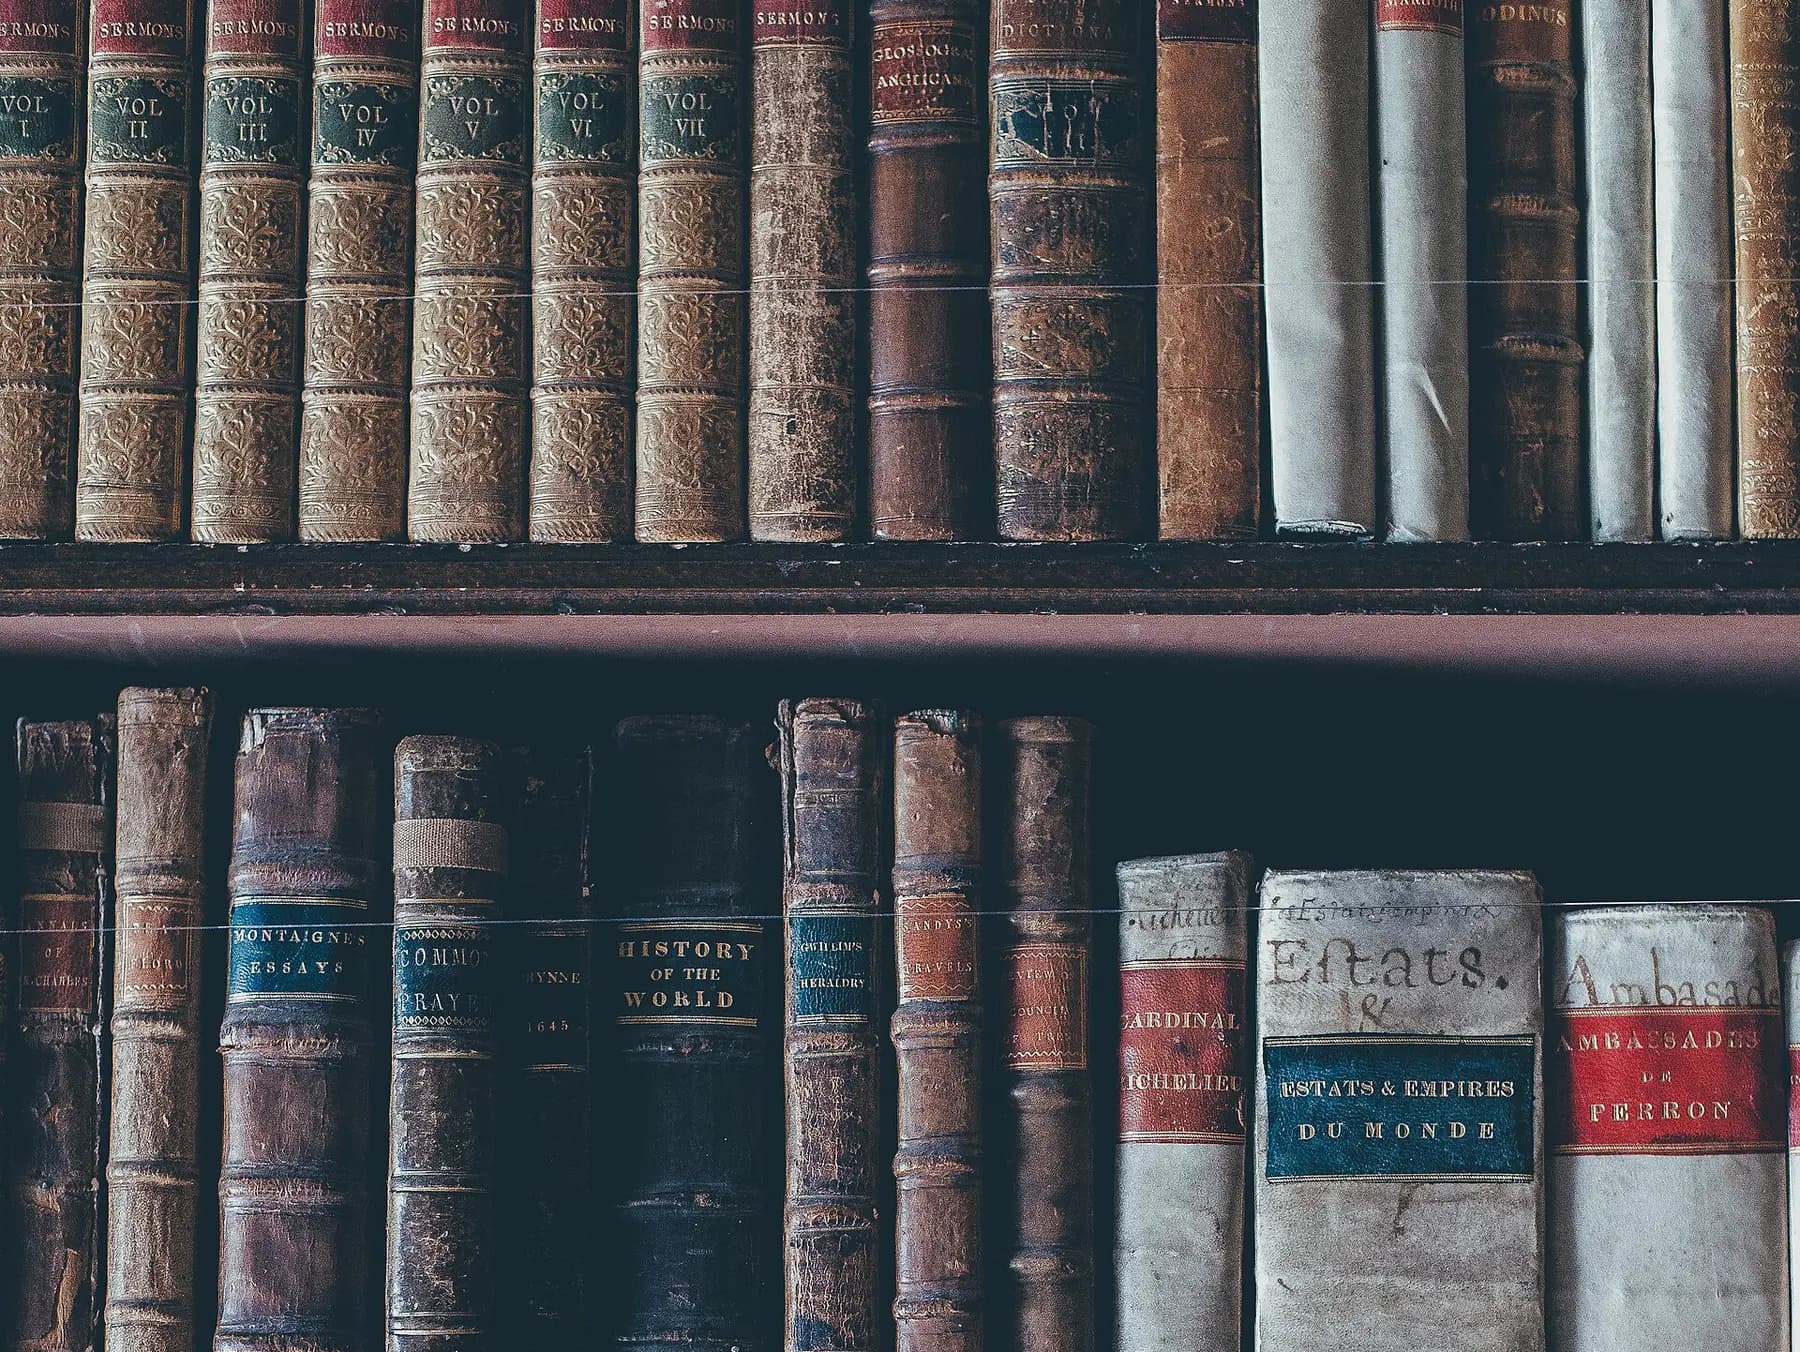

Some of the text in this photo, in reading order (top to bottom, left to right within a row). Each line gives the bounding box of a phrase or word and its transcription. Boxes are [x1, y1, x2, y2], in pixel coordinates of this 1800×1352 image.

[434, 17, 518, 35] SERMONS
[542, 17, 625, 34] SERMONS
[649, 15, 735, 33] SERMONS
[756, 11, 839, 26] SERMONS
[100, 22, 184, 39] SERMONS
[214, 21, 296, 38] SERMONS
[325, 22, 408, 42] SERMONS
[2, 96, 48, 113] VOL
[116, 97, 163, 116] VOL
[225, 96, 272, 115] VOL
[450, 96, 498, 116] VOL
[558, 92, 603, 117] VOL
[664, 92, 711, 112] VOL
[340, 104, 388, 124] VOL
[465, 121, 479, 140] V
[234, 929, 365, 945] MONTAIGNES
[618, 940, 755, 961] HISTORY
[250, 960, 343, 974] ESSAYS
[650, 967, 721, 981] OF THE
[400, 991, 490, 1013] PRAYE
[624, 990, 734, 1009] WORLD
[1641, 1070, 1672, 1084] DE
[1280, 1080, 1515, 1098] ESTATS & EMPIRES
[1590, 1101, 1732, 1123] PERRON
[1298, 1122, 1495, 1140] DU MONDE
